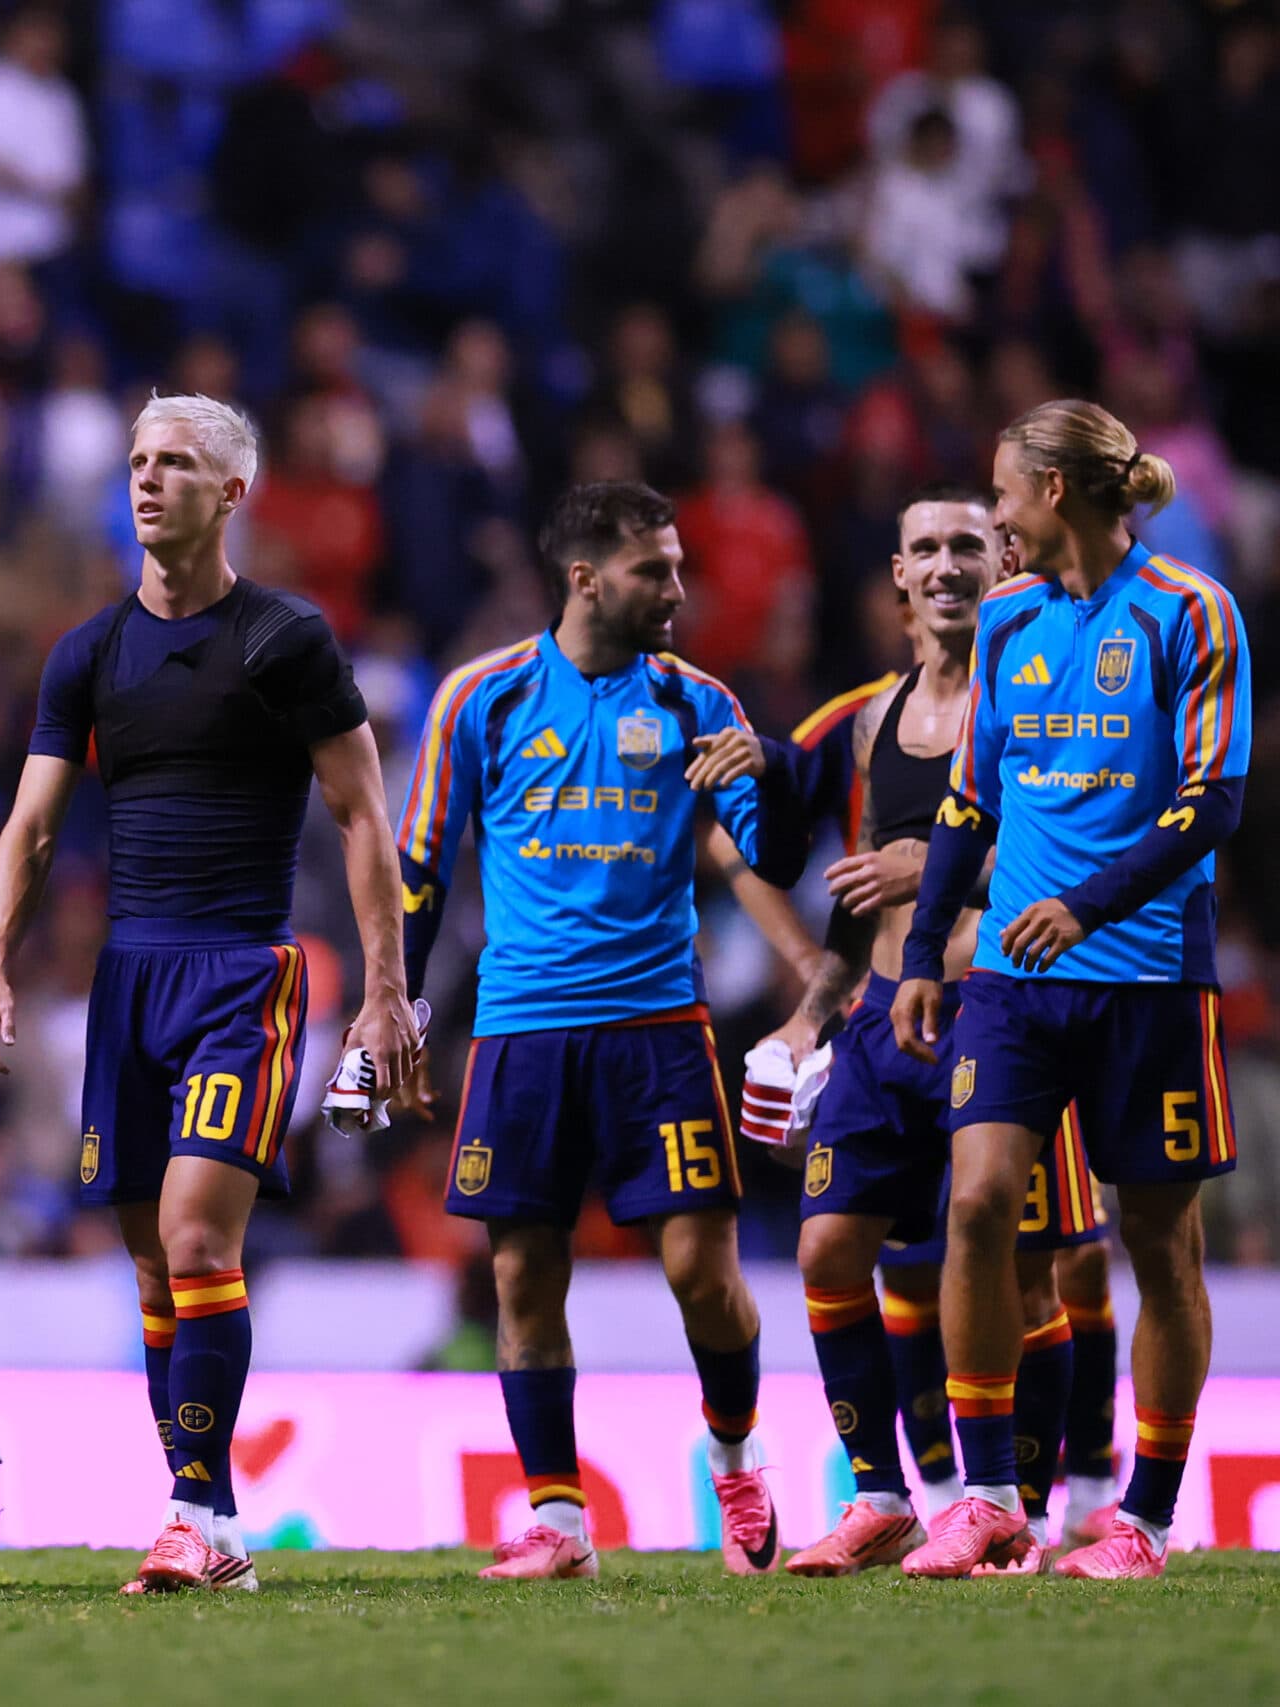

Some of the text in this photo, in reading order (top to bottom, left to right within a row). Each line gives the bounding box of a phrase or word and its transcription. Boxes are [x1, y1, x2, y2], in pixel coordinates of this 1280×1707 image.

[1013, 713, 1130, 738] EBRO
[1046, 767, 1136, 792] mapfre
[524, 786, 658, 813] EBRO
[556, 841, 656, 864] mapfre
[181, 1072, 242, 1140] 10
[1163, 1090, 1200, 1162] 5
[658, 1119, 720, 1192] 15
